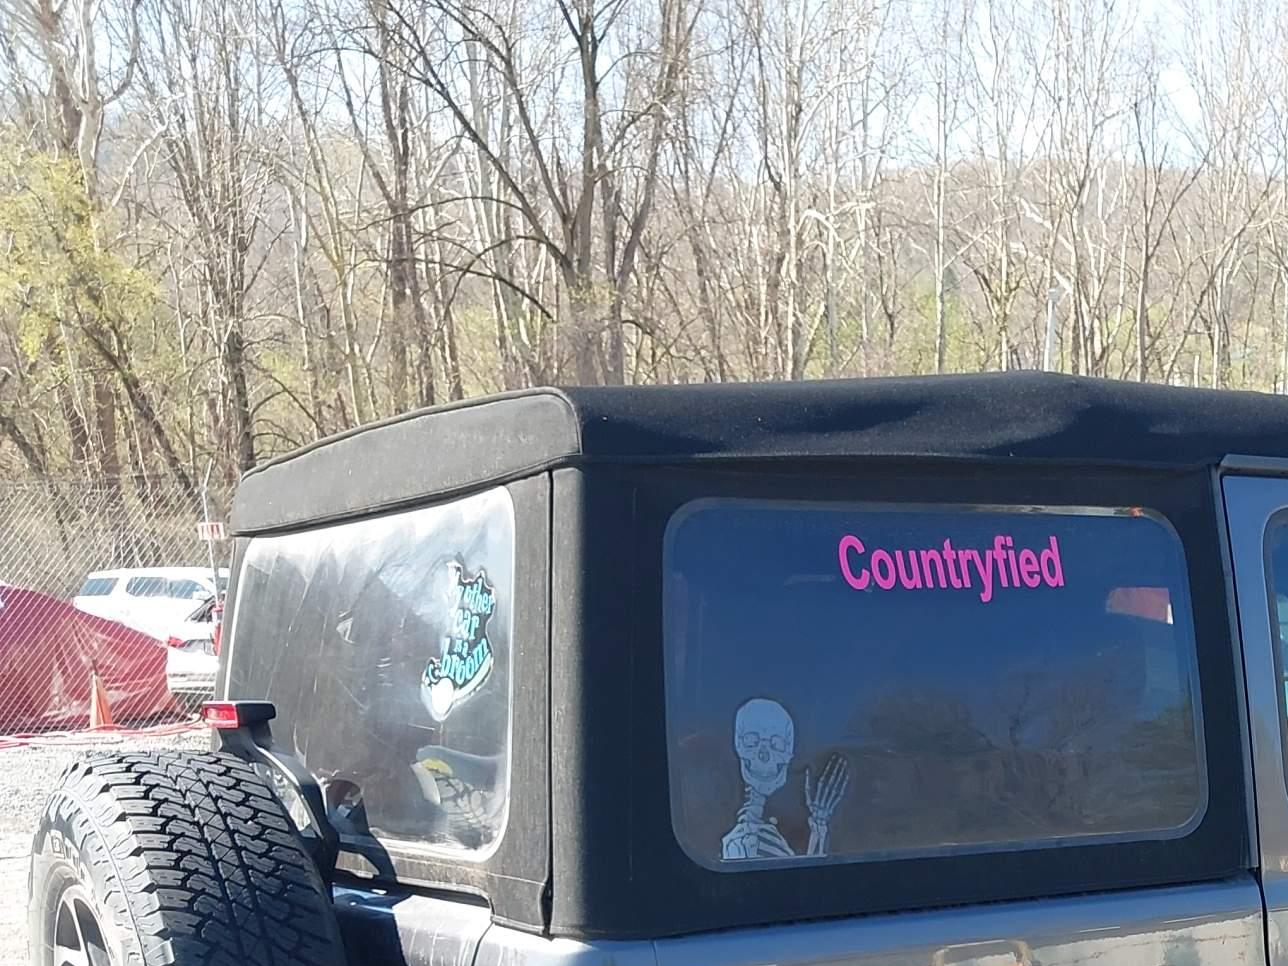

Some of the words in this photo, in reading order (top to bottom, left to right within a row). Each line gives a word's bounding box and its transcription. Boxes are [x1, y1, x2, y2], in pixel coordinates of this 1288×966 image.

[838, 534, 1066, 603] Countryfied
[463, 577, 494, 615] other
[453, 608, 480, 640] car
[440, 637, 489, 686] broom
